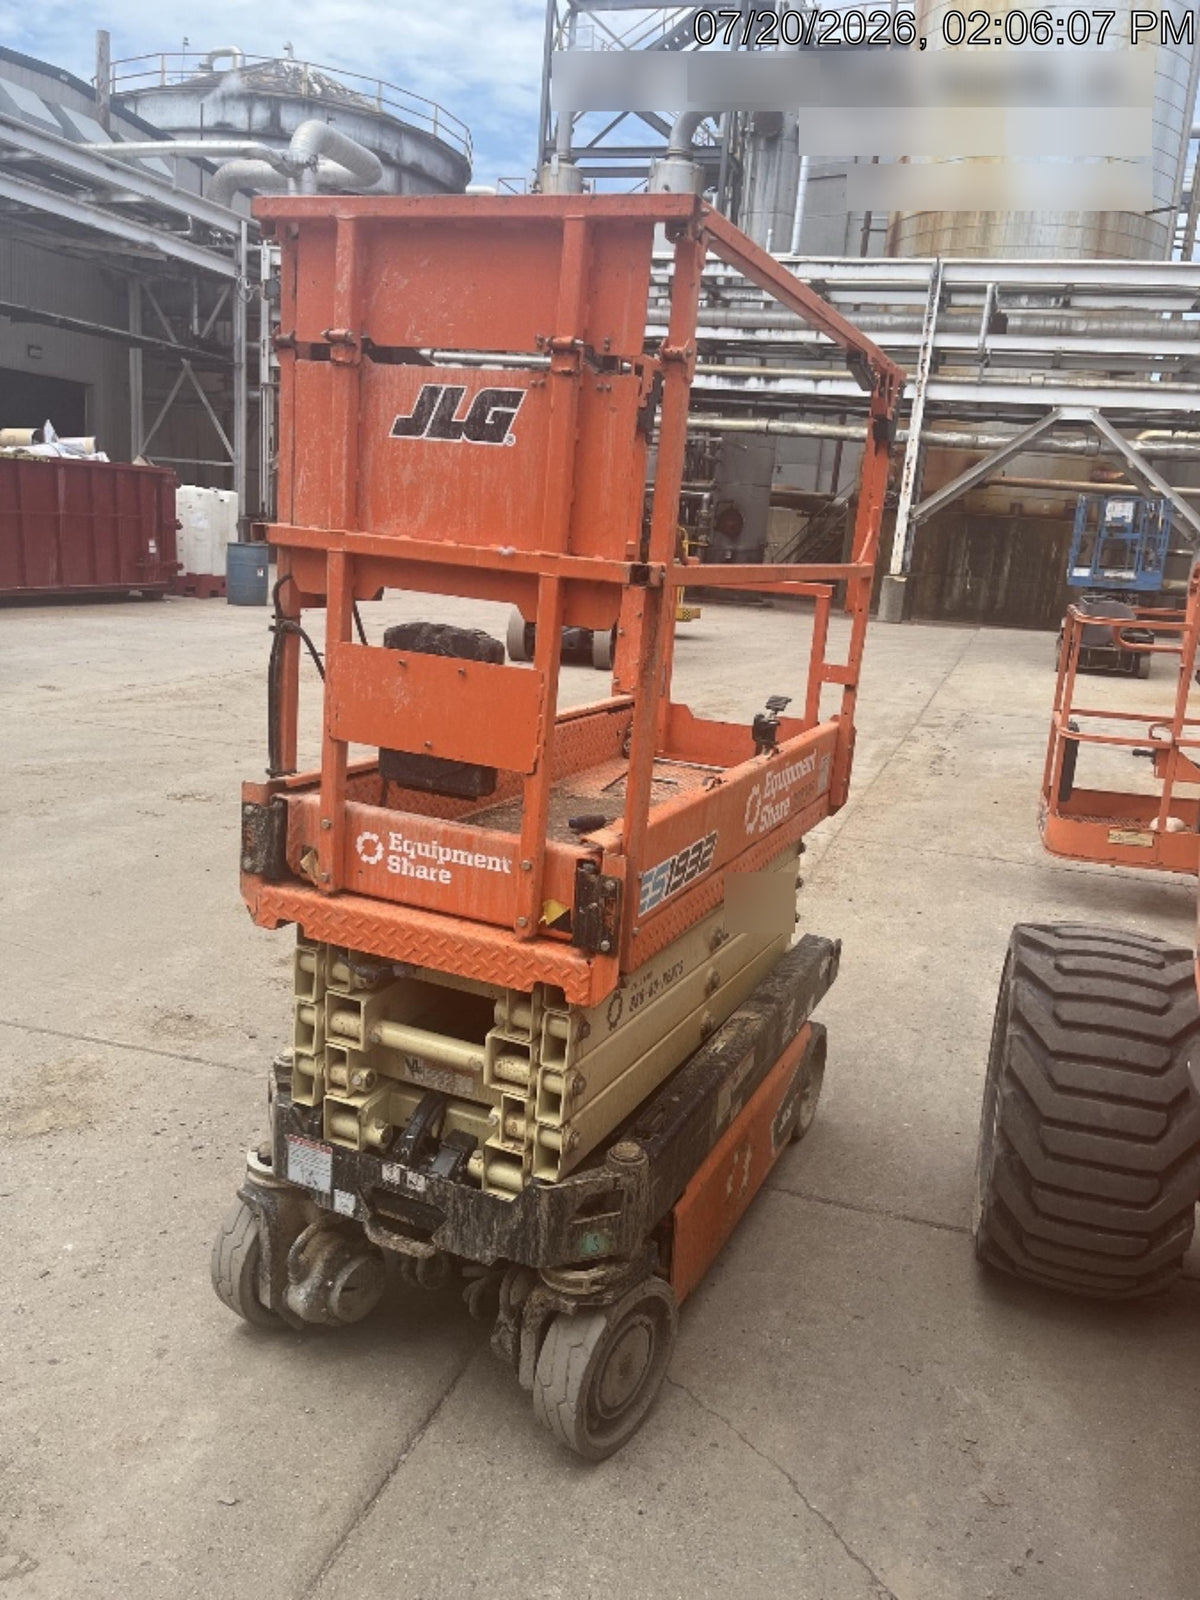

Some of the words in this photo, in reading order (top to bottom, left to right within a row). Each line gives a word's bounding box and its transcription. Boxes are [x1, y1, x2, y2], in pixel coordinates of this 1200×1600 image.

[389, 384, 527, 445] JLG
[387, 854, 452, 884] Share
[388, 831, 512, 874] Equipment
